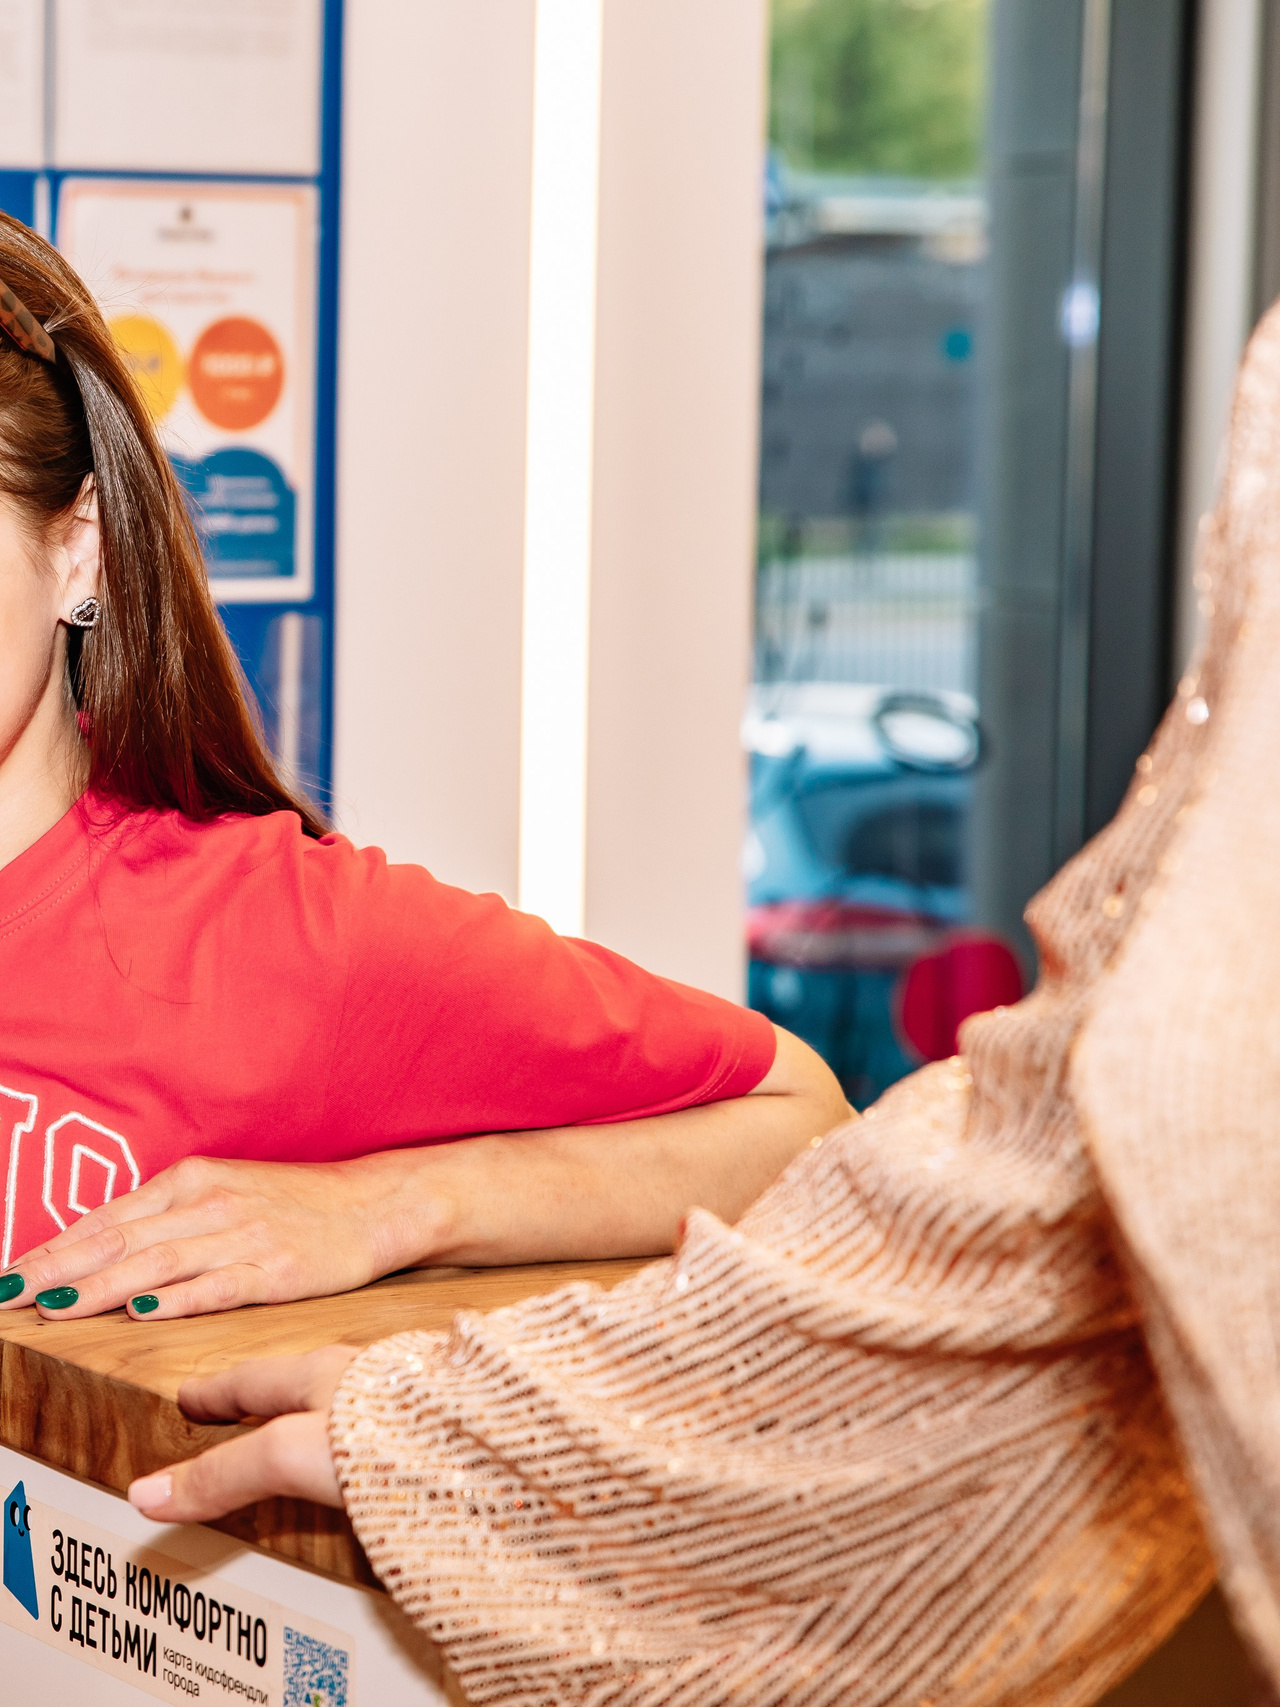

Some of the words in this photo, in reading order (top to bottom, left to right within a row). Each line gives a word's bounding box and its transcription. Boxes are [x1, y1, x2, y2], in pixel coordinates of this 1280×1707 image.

[50, 1584, 62, 1632] С
[69, 1595, 157, 1678] ДЕТЬМИ
[51, 1529, 117, 1599] ЗДЕСЬ
[125, 1561, 268, 1668] КОМФОРТНО
[162, 1667, 200, 1698] города
[163, 1646, 193, 1672] карта
[194, 1659, 269, 1705] кидсфрендли
